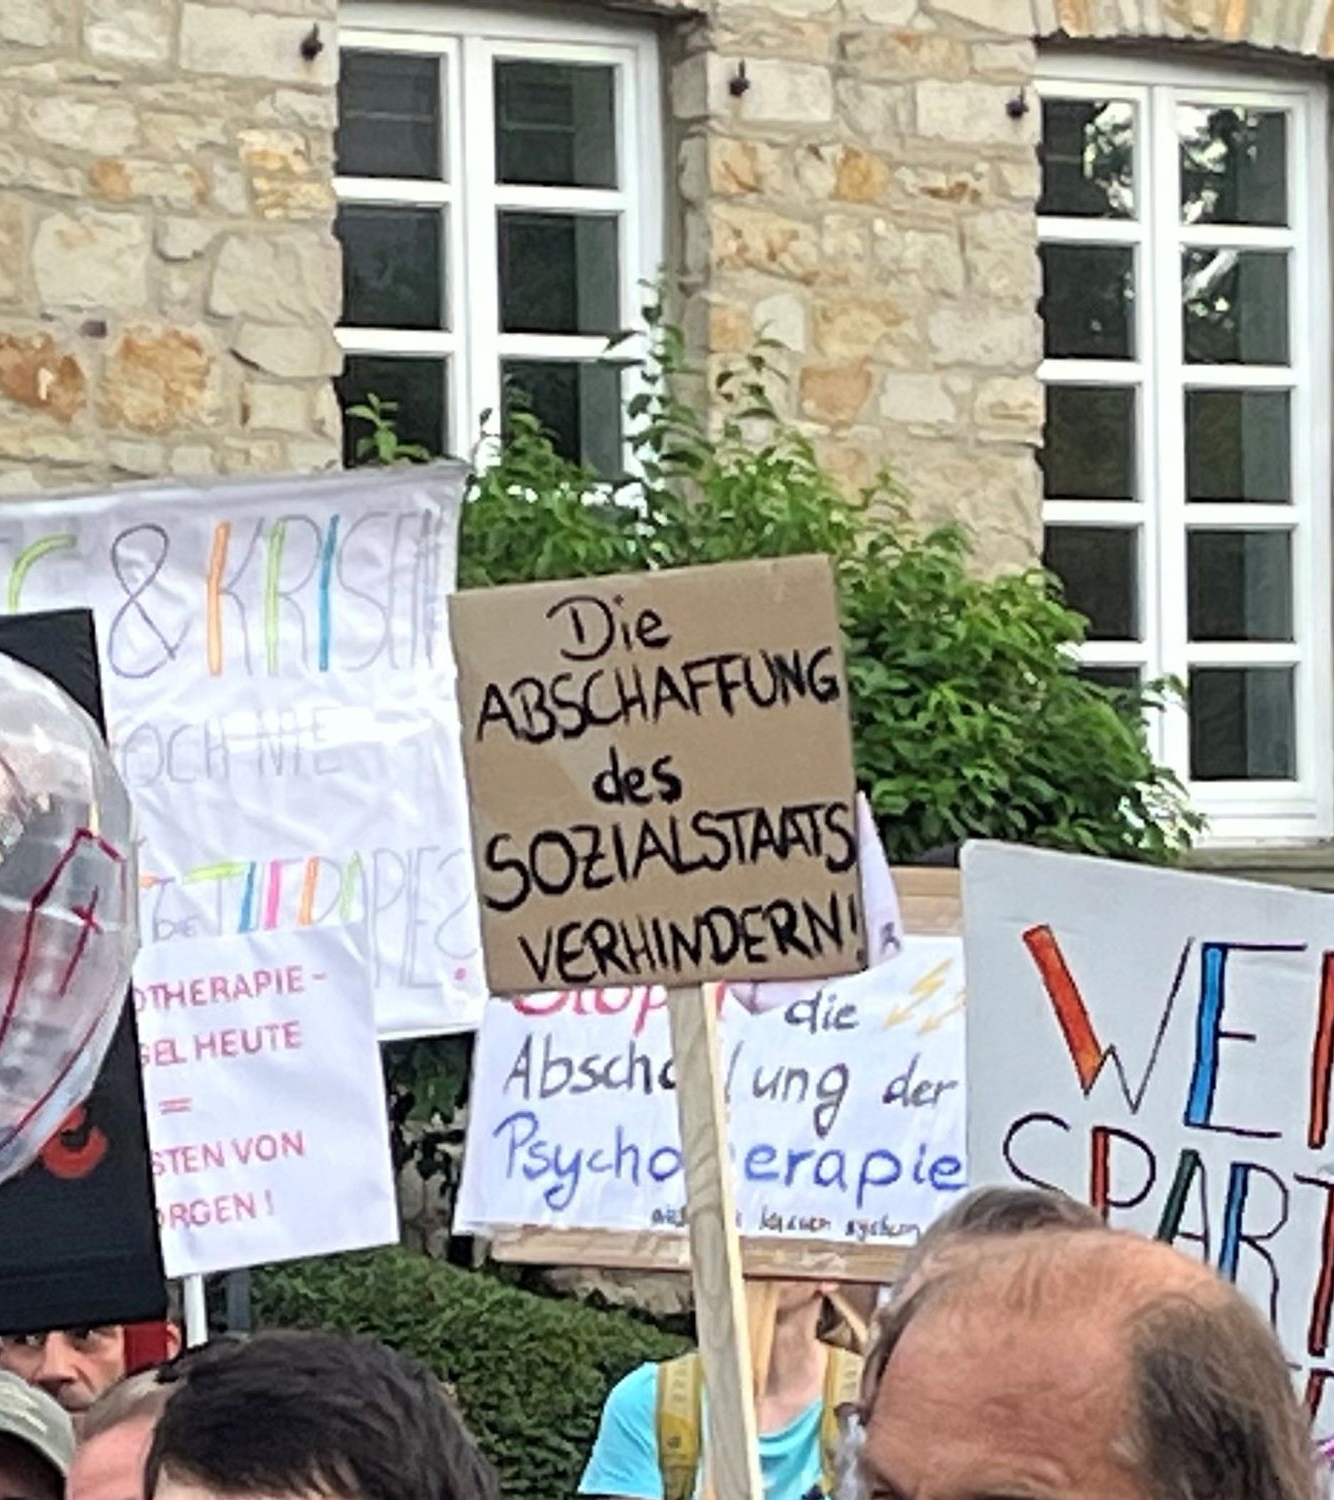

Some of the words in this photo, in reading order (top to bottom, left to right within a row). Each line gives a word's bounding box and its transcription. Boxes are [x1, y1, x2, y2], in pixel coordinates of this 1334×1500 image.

[108, 521, 189, 679] &
[546, 594, 671, 661] Die
[475, 644, 841, 744] ABSCHAFFUNG
[120, 718, 231, 788] OCH
[592, 745, 684, 805] des
[482, 802, 861, 912] SOZIALSTAATS
[517, 890, 869, 984] VERHINDERN!
[133, 965, 305, 1012] OTHERAPIE
[784, 983, 861, 1036] die
[194, 1020, 304, 1061] HEUTE
[503, 1032, 849, 1139] Abschaung
[882, 1052, 959, 1108] der
[152, 1141, 226, 1177] STEN
[231, 1130, 305, 1165] VON
[492, 1110, 967, 1211] Psychoerapie
